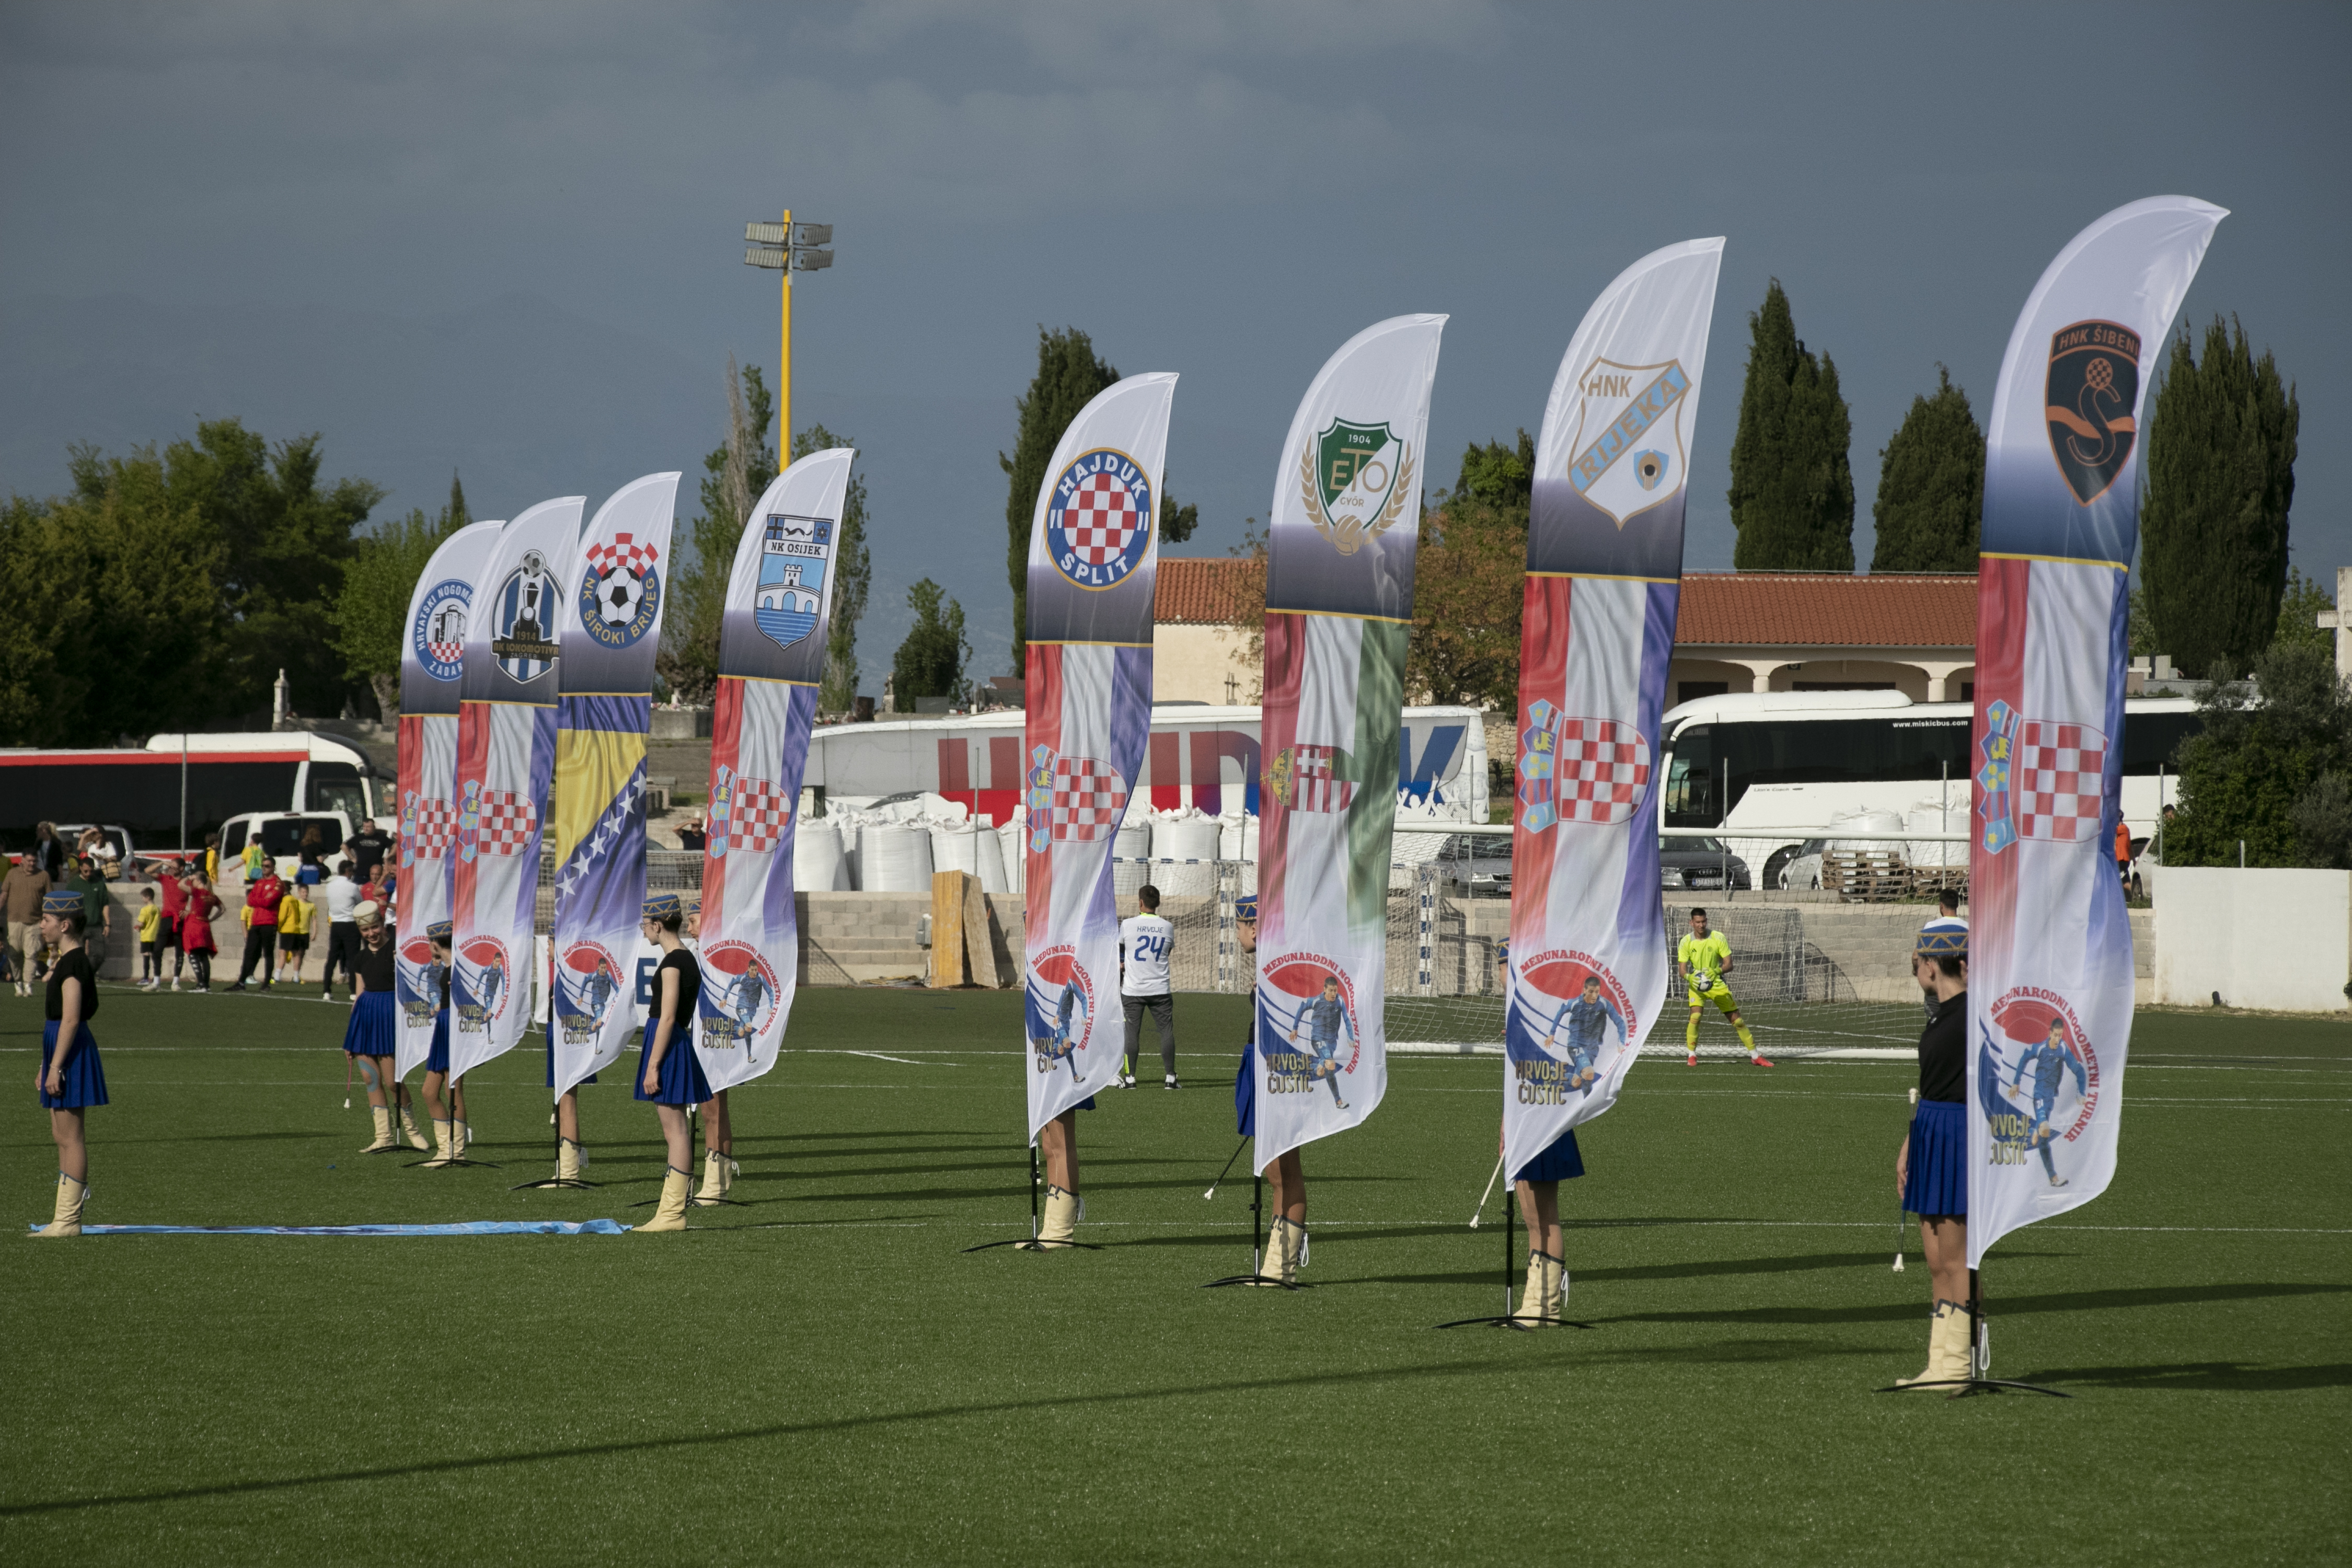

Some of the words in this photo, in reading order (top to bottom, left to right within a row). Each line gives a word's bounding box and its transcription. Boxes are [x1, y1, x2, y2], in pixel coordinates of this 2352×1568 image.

[2059, 329, 2088, 350] HNK
[2093, 325, 2139, 356] ŠIBENI
[1588, 375, 1633, 397] HNK
[1348, 434, 1370, 444] 1904
[1578, 379, 1678, 480] RIJEKA
[1058, 454, 1147, 500] HAJDUK
[1329, 448, 1388, 493] ETO
[1340, 496, 1364, 507] GYŐR
[771, 542, 784, 552] NK
[787, 543, 822, 556] OSIJEK
[1060, 552, 1128, 584] SPLIT
[583, 577, 596, 600] NK
[417, 595, 436, 651] HRVATSKI
[437, 584, 473, 604] NOGOME
[630, 577, 656, 638] BRIJEG
[516, 631, 536, 641] 1914
[584, 609, 625, 644] ŠIROKI
[493, 642, 504, 651] NK
[506, 643, 559, 655] LOKOMOTIVA
[1134, 935, 1166, 962] 24
[756, 953, 781, 1005] NOGOMETNI
[1073, 959, 1094, 1013] OGOMETNI
[1339, 967, 1359, 1037] NOGOMETNI
[758, 1006, 778, 1036] TURNIR
[1078, 1015, 1094, 1051] TURNIR
[1266, 1053, 1313, 1072] HRVOJE
[1345, 1039, 1360, 1075] TURNIR
[2067, 1006, 2100, 1089] NOGOMETNI
[1515, 1060, 1569, 1081] HRVOJE
[2064, 1092, 2098, 1143] TURNIR
